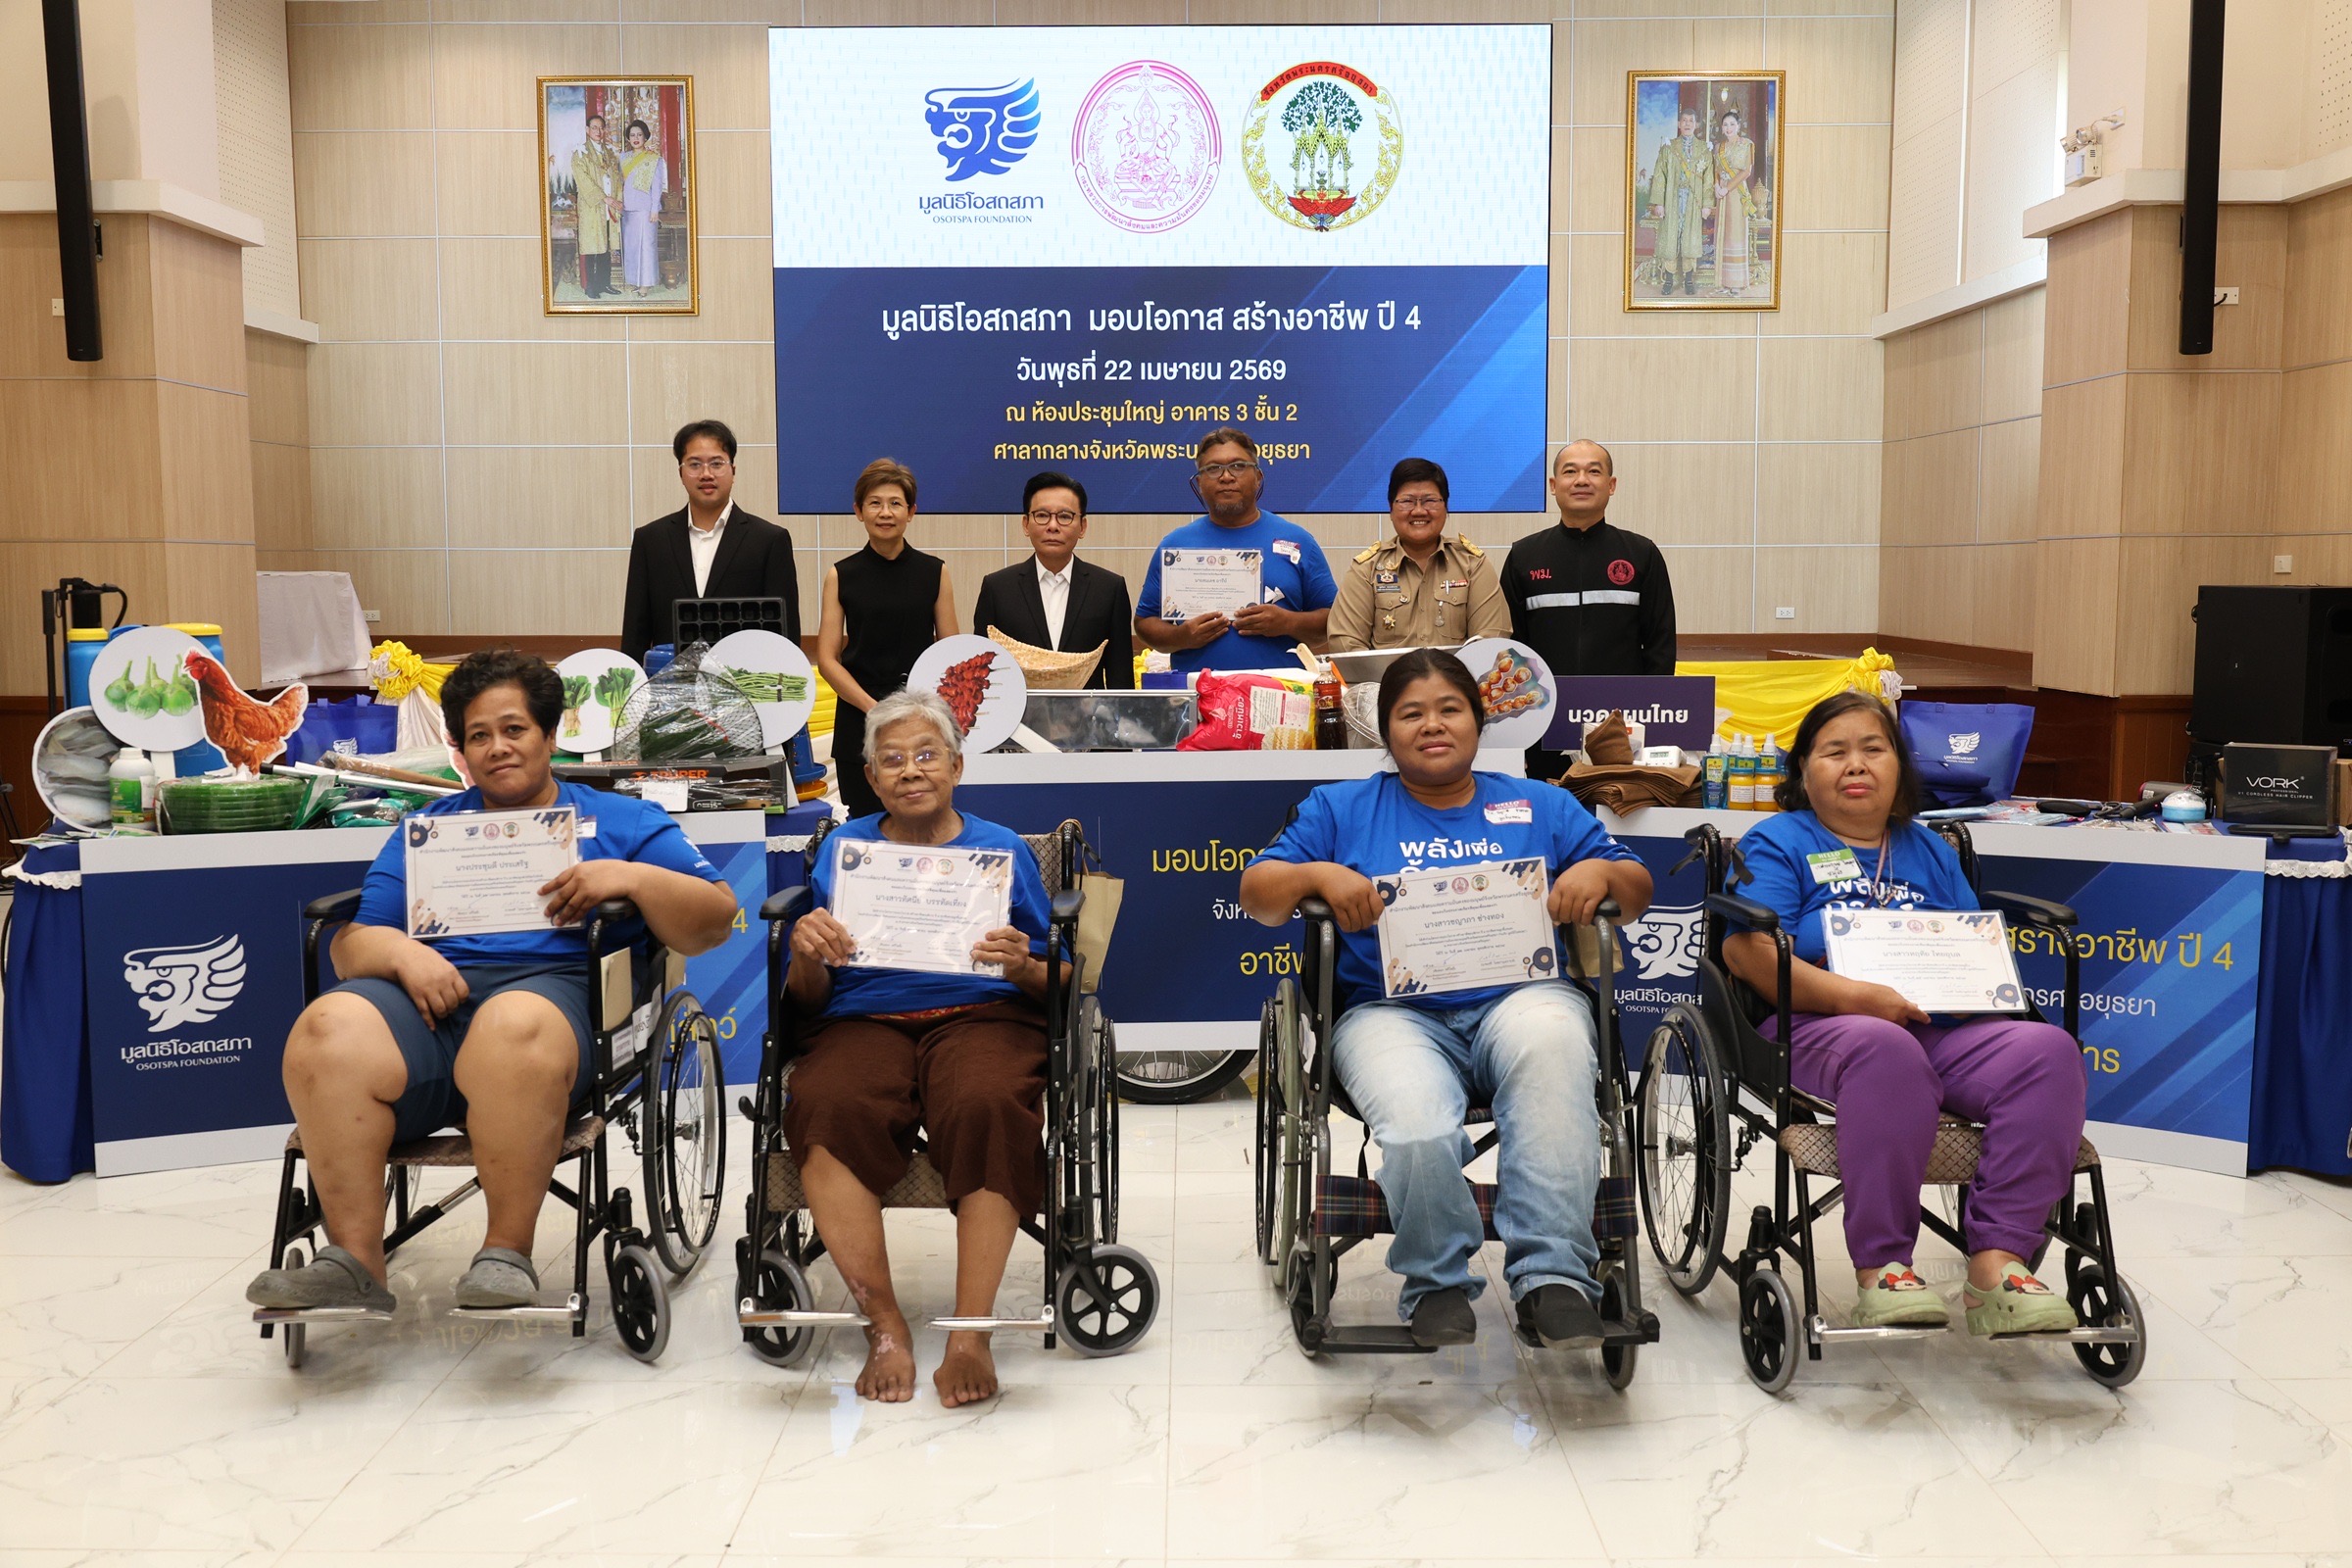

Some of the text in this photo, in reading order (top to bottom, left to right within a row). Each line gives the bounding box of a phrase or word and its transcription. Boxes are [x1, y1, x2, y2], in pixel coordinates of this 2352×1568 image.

[918, 191, 1044, 215] มูลนิธิโอสถสภา
[932, 215, 1033, 223] OSOTSPA FOUNDATION
[882, 300, 1421, 341] มูลนิธิโอสถสภา มอบโอกาส สร้างอาชีพ ปี 4
[1016, 349, 1287, 388] วันพุธที่ 22 เมษายน 2569
[1005, 394, 1298, 427] ณ ห้องประชุมใหญ่ อาคาร 3 ชั้น 2
[1568, 704, 1689, 723] นวดผนไทย
[2246, 776, 2300, 790] VORK
[1399, 837, 1503, 858] พลังเพื่อ
[732, 907, 748, 933] 4
[2178, 932, 2202, 968] ปี
[2213, 942, 2233, 970] 4
[1625, 1004, 1660, 1013] OSOTSPA
[121, 1037, 252, 1064] มูลนิธิโอสถสภา
[135, 1055, 241, 1071] OSOTSPA FOUNDATION
